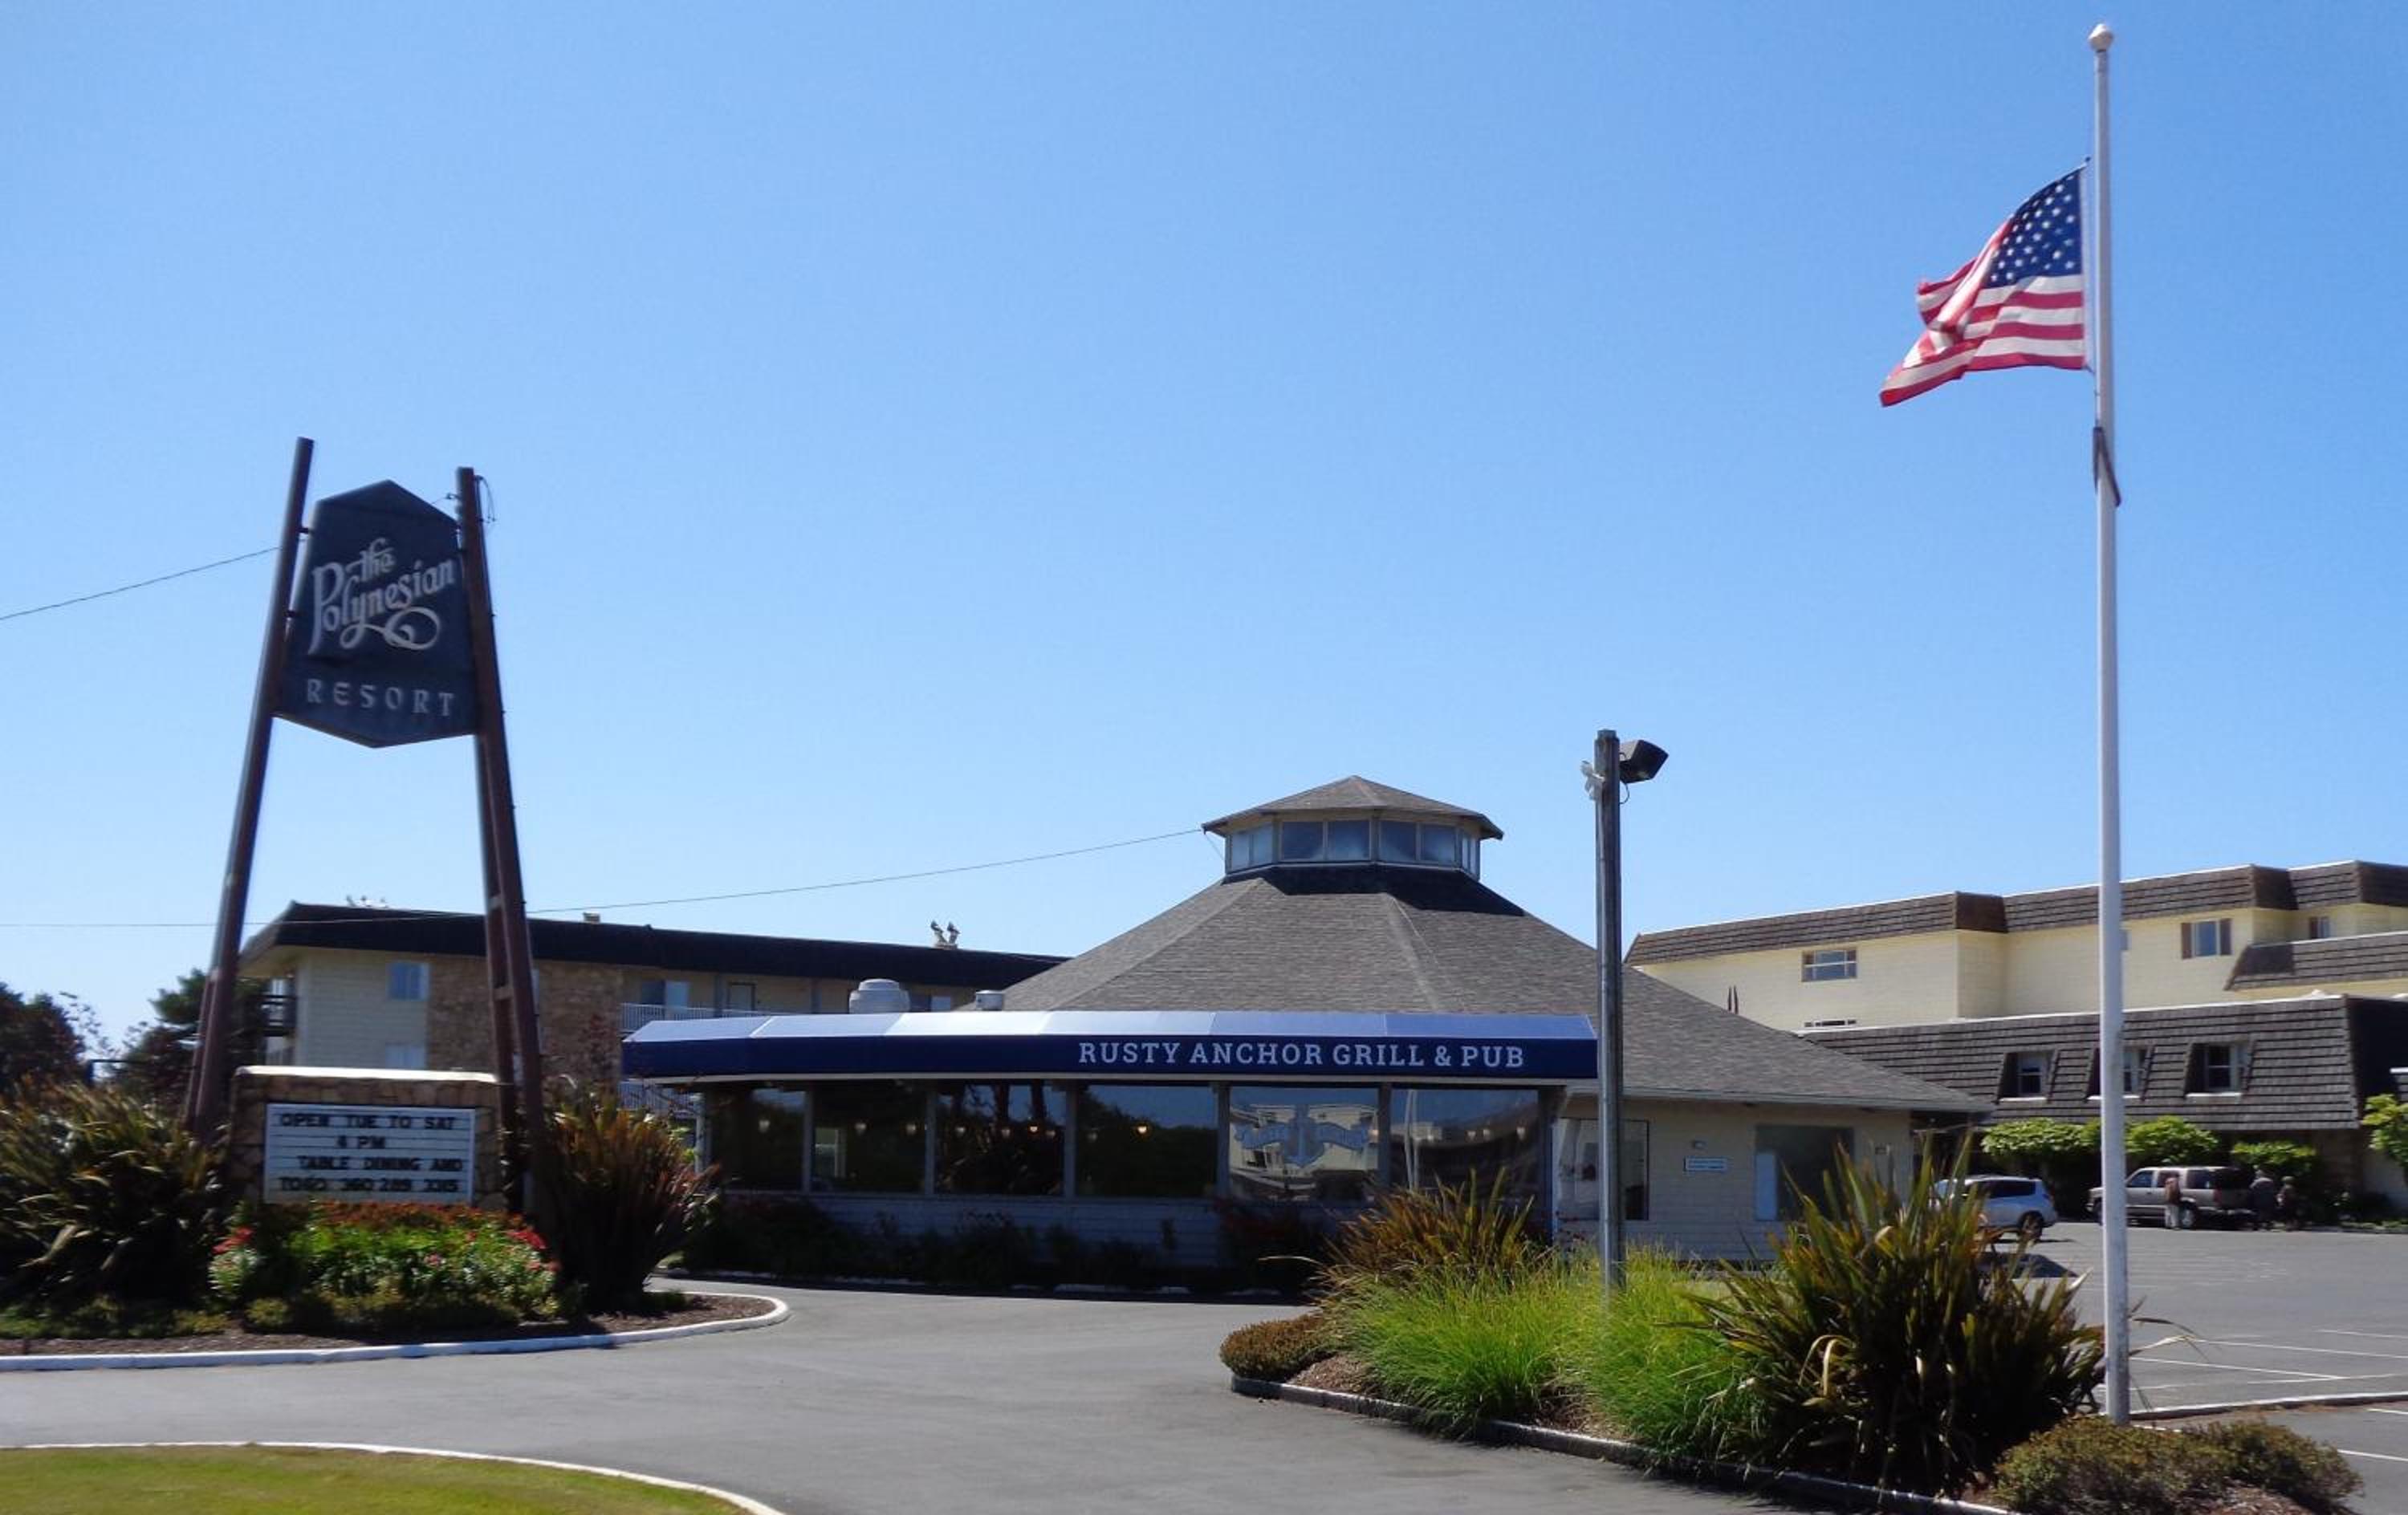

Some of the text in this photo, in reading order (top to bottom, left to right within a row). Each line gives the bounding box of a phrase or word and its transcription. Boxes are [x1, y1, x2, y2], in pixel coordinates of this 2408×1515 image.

[345, 537, 395, 582] the
[307, 559, 456, 656] Polynesian
[306, 678, 455, 717] RESORT
[1079, 1042, 1523, 1068] RUSTY ANCHOR GRILL & PUB
[281, 1112, 455, 1130] OPEN TUE TO SAT
[336, 1135, 386, 1149] 4 PM
[429, 1158, 463, 1172] AND
